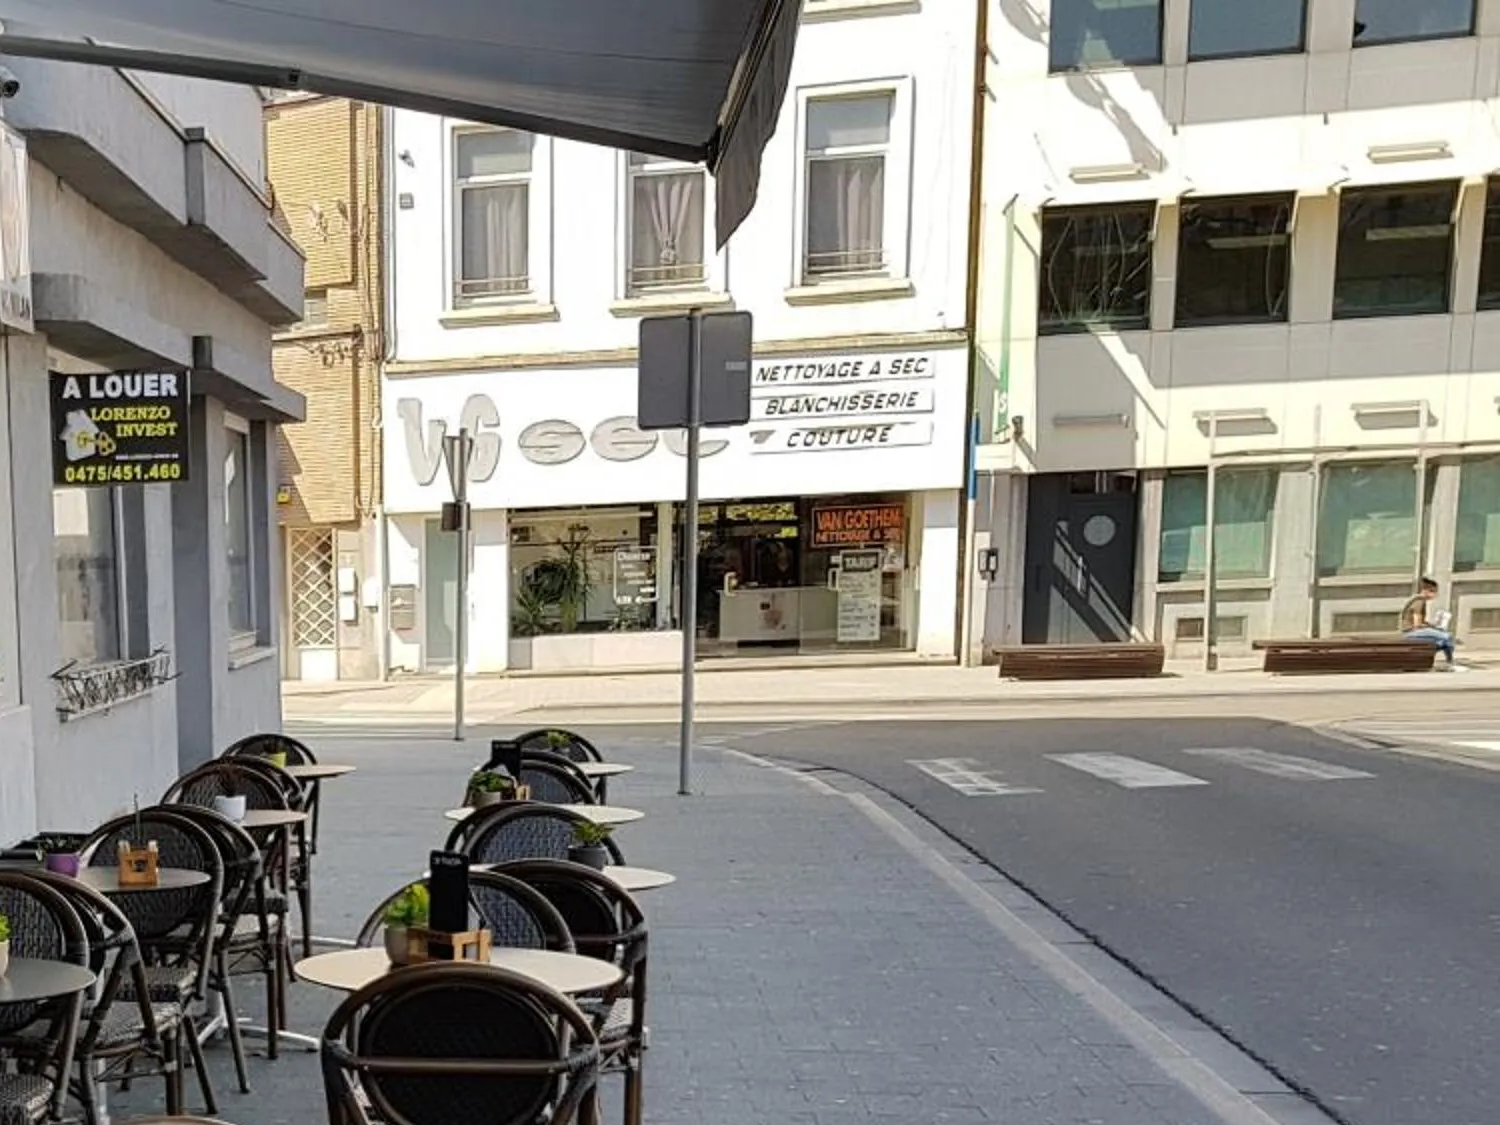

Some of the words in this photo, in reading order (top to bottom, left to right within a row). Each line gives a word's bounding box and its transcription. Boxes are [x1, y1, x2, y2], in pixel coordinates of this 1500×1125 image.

[756, 361, 863, 382] NETTOYAGE
[869, 360, 881, 376] A
[888, 357, 929, 376] SEC
[62, 376, 82, 399] A
[89, 373, 179, 399] LOUER
[91, 405, 171, 421] LORENZO
[765, 391, 919, 416] BLANCHISSERIE
[115, 422, 178, 437] INVEST
[787, 427, 892, 448] COUTURE
[65, 463, 180, 482] 0475/451.460
[816, 511, 843, 531] VAN
